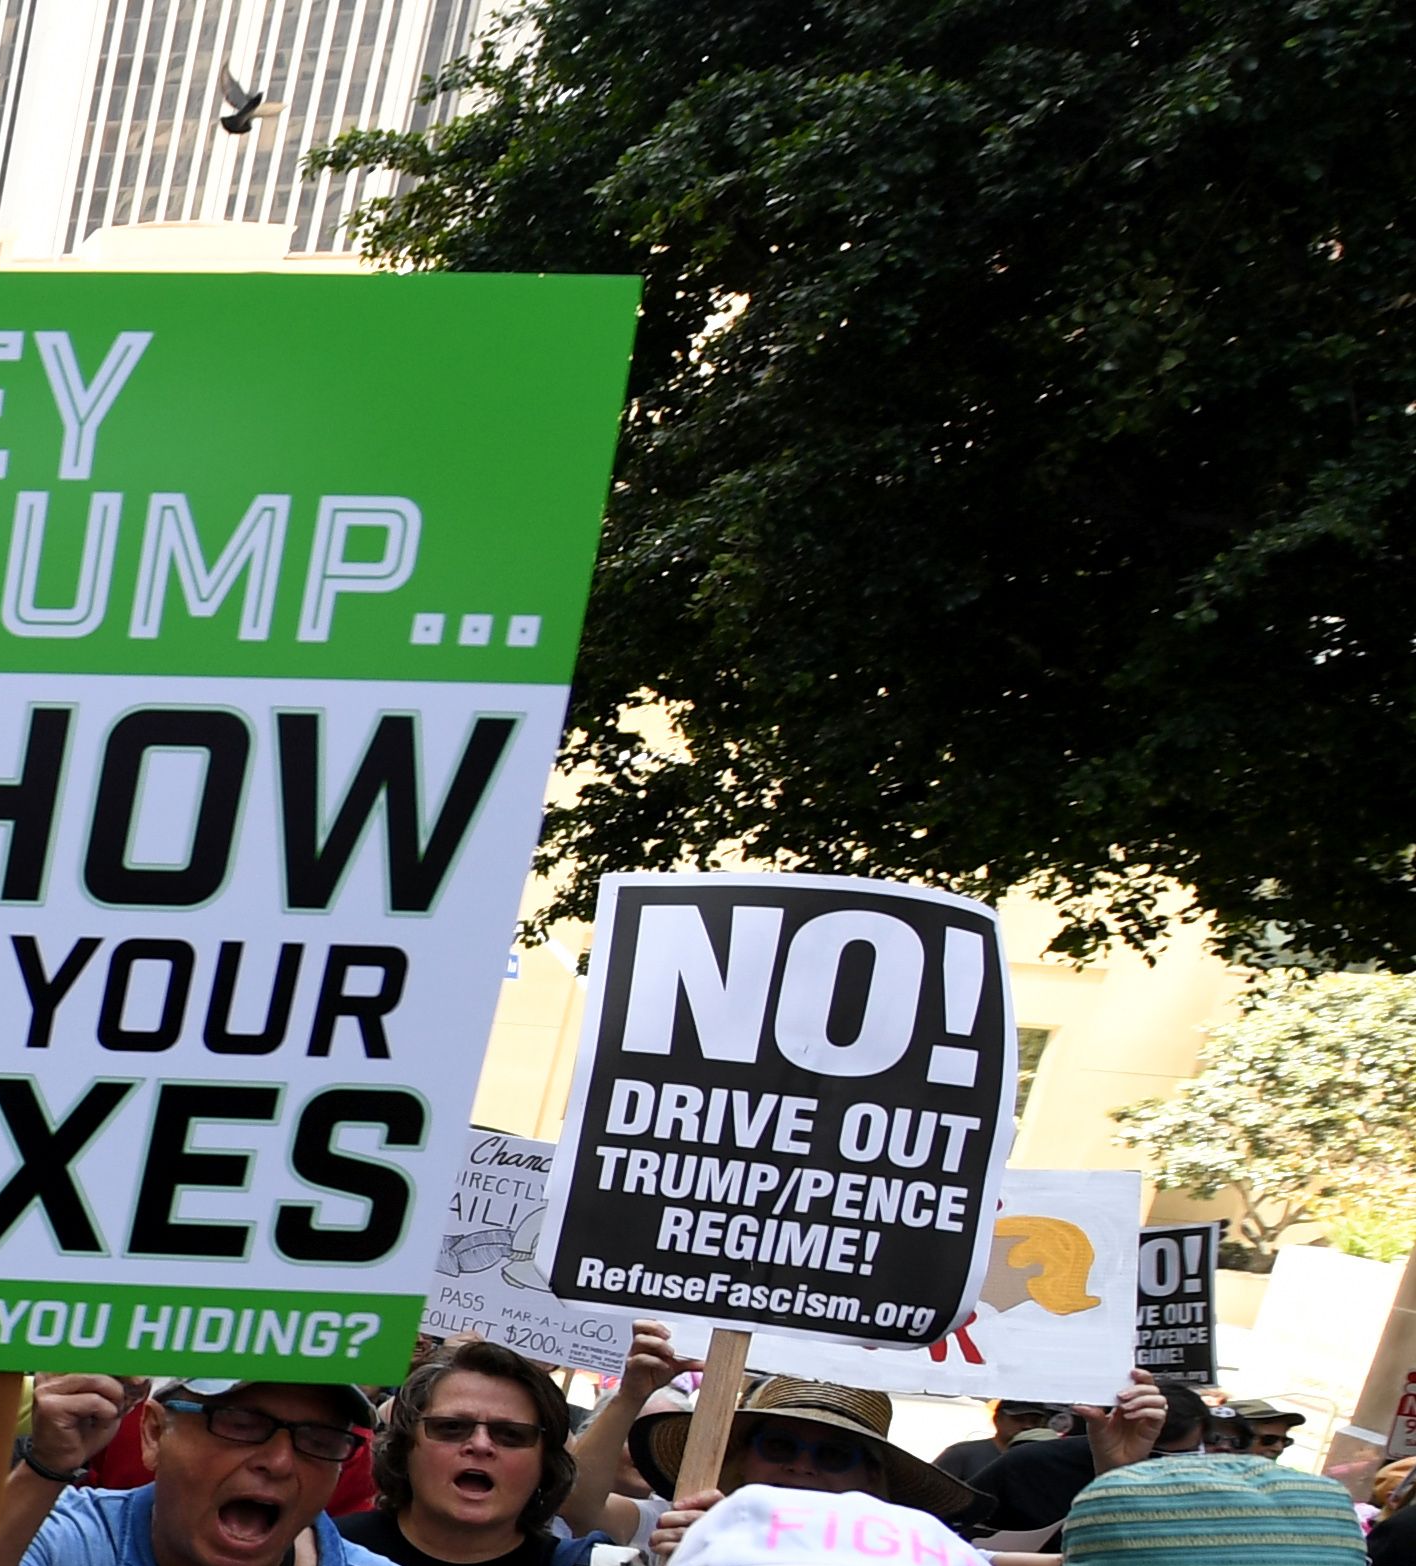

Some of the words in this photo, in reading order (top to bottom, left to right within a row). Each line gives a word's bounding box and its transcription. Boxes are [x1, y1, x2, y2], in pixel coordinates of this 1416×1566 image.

[11, 935, 410, 1060] YOUR
[621, 904, 984, 1088] NO!
[605, 1078, 819, 1156] DRIVE
[839, 1101, 981, 1174] OUT
[596, 1146, 969, 1233] TRUMP/PENCE
[656, 1206, 881, 1276] REGIME!
[126, 1306, 381, 1358] HIDING?
[440, 1287, 485, 1312] PASS
[576, 1256, 936, 1337] RefuseFascism.org
